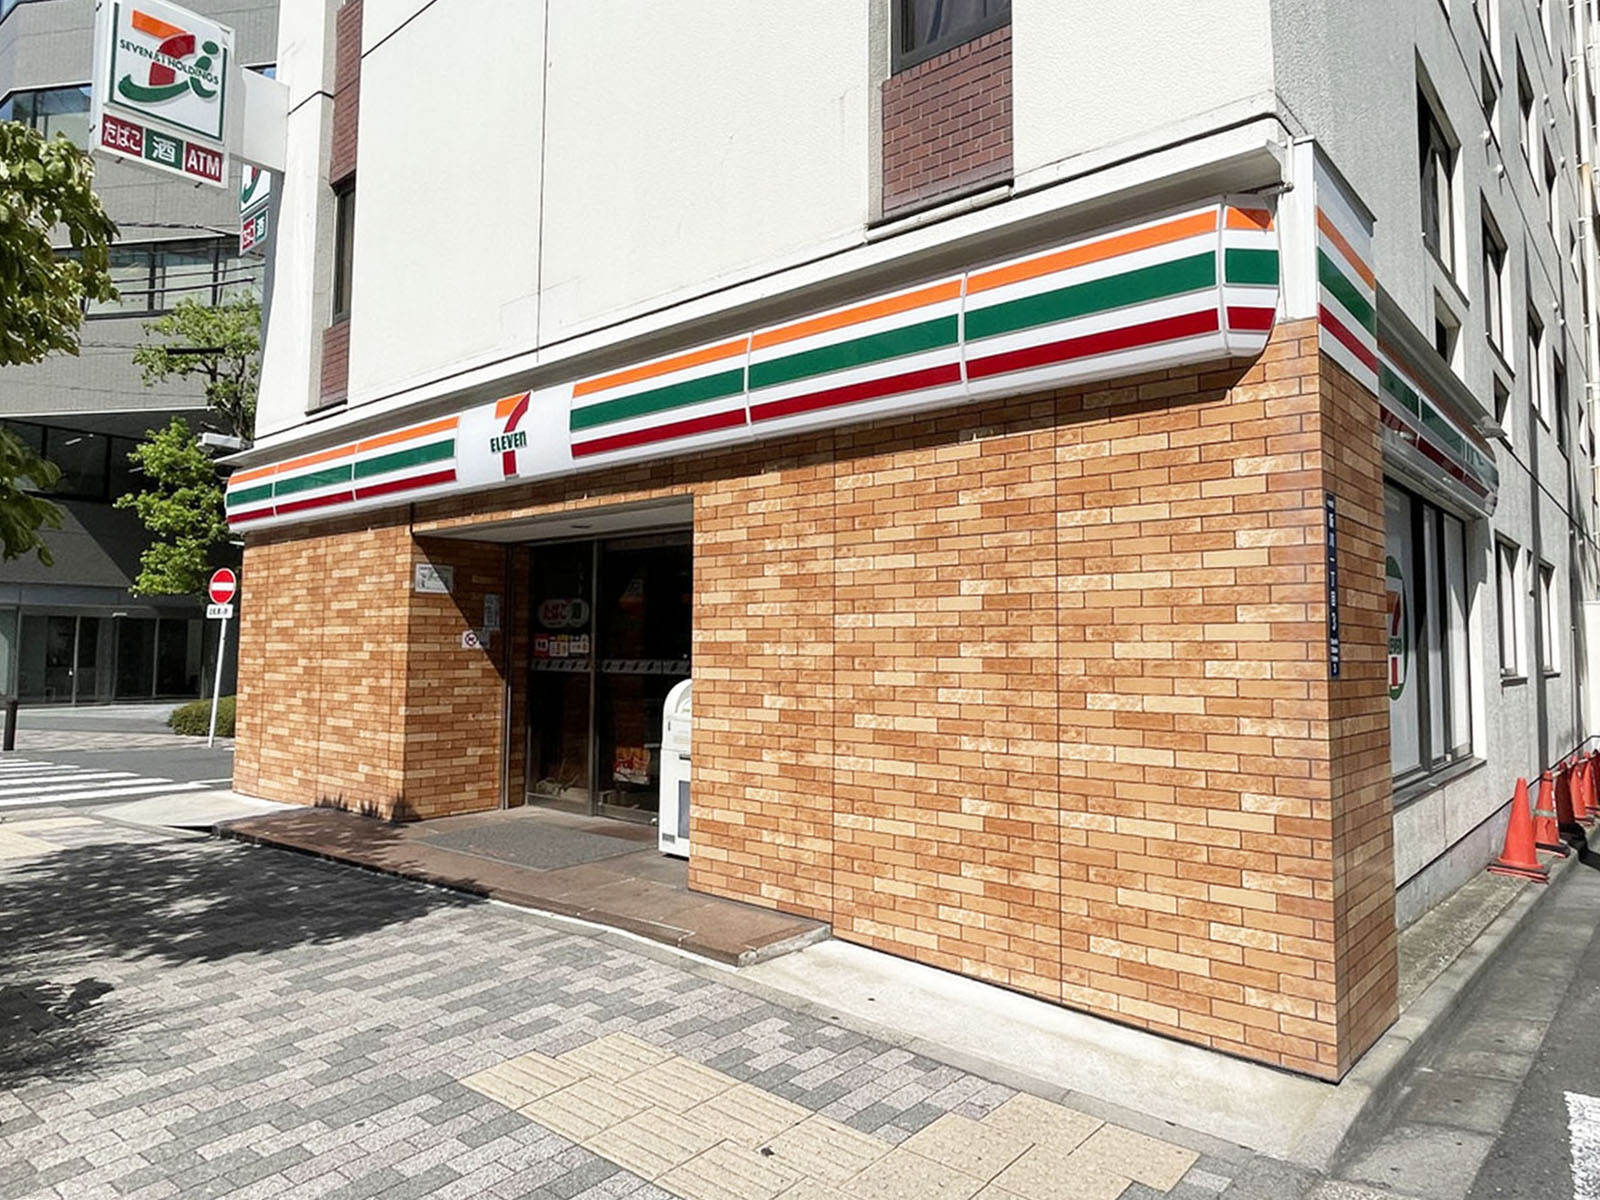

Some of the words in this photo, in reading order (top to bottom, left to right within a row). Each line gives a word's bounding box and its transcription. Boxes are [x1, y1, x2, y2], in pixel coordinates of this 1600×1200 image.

[103, 120, 141, 151] たばこ
[152, 135, 177, 163] 酒
[187, 149, 220, 178] ATM
